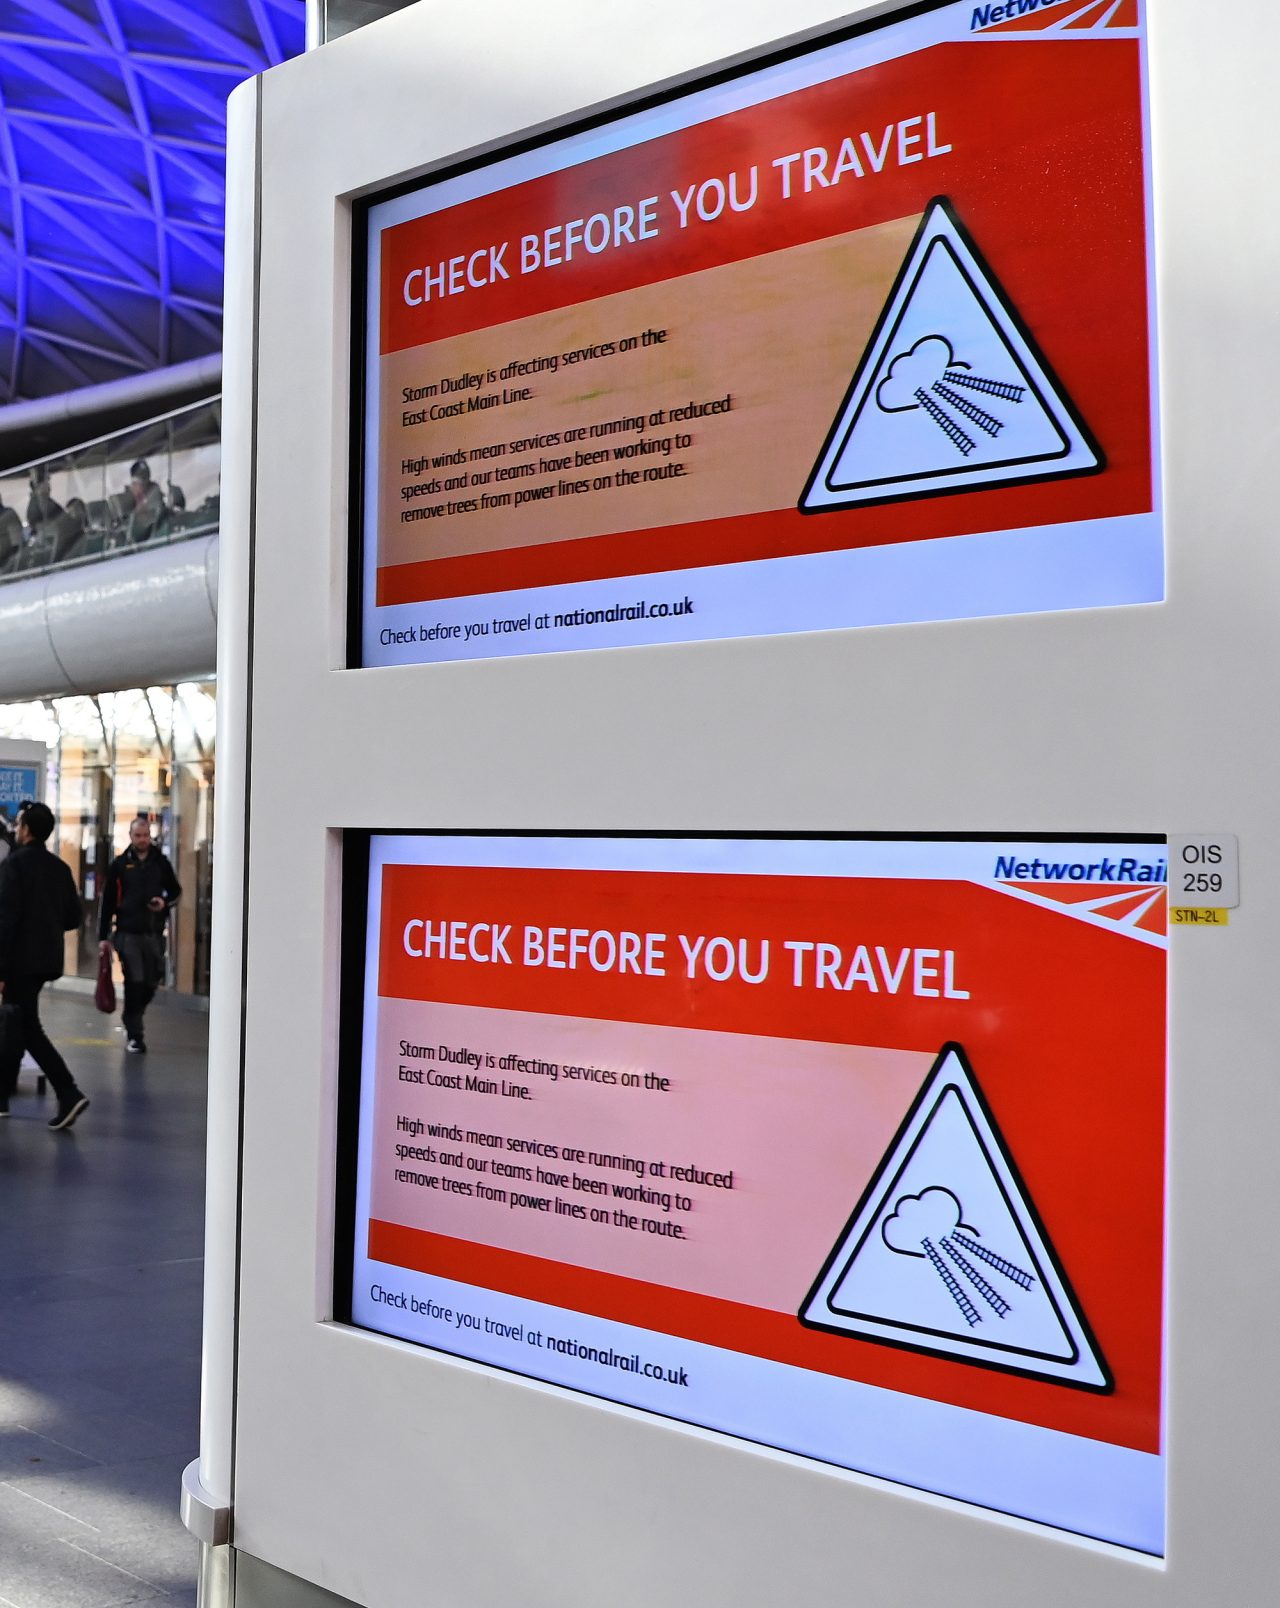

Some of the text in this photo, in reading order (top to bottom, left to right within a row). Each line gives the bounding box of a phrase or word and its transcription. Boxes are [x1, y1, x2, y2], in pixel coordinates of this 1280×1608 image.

[403, 111, 953, 306] CHECK BEFORE YOU TRAVEL
[402, 328, 667, 404] Storm Dudley is affecting services on the
[401, 395, 732, 476] High winds mean services are running at reduced
[403, 386, 533, 427] East Coast Main Line.
[401, 432, 691, 502] speeds and our teams have been working to
[401, 462, 687, 523] remove trees from power lines on the route.
[380, 597, 694, 645] Check before you travel at nationalrail.co.uk
[1182, 845, 1222, 864] OIS
[1183, 874, 1222, 892] 259
[403, 919, 970, 1000] CHECK BEFORE YOU TRAVEL
[398, 1065, 532, 1100] East Coast Main Line.
[399, 1040, 670, 1092] Storm Dudley is affecting services on the
[395, 1141, 692, 1211] speeds and our teams have been working to
[396, 1115, 733, 1189] High winds mean services are running at reduced
[394, 1167, 687, 1240] remove trees from power lines on the route.
[370, 1284, 688, 1387] Check before you travel at nationalrail.co.uk
